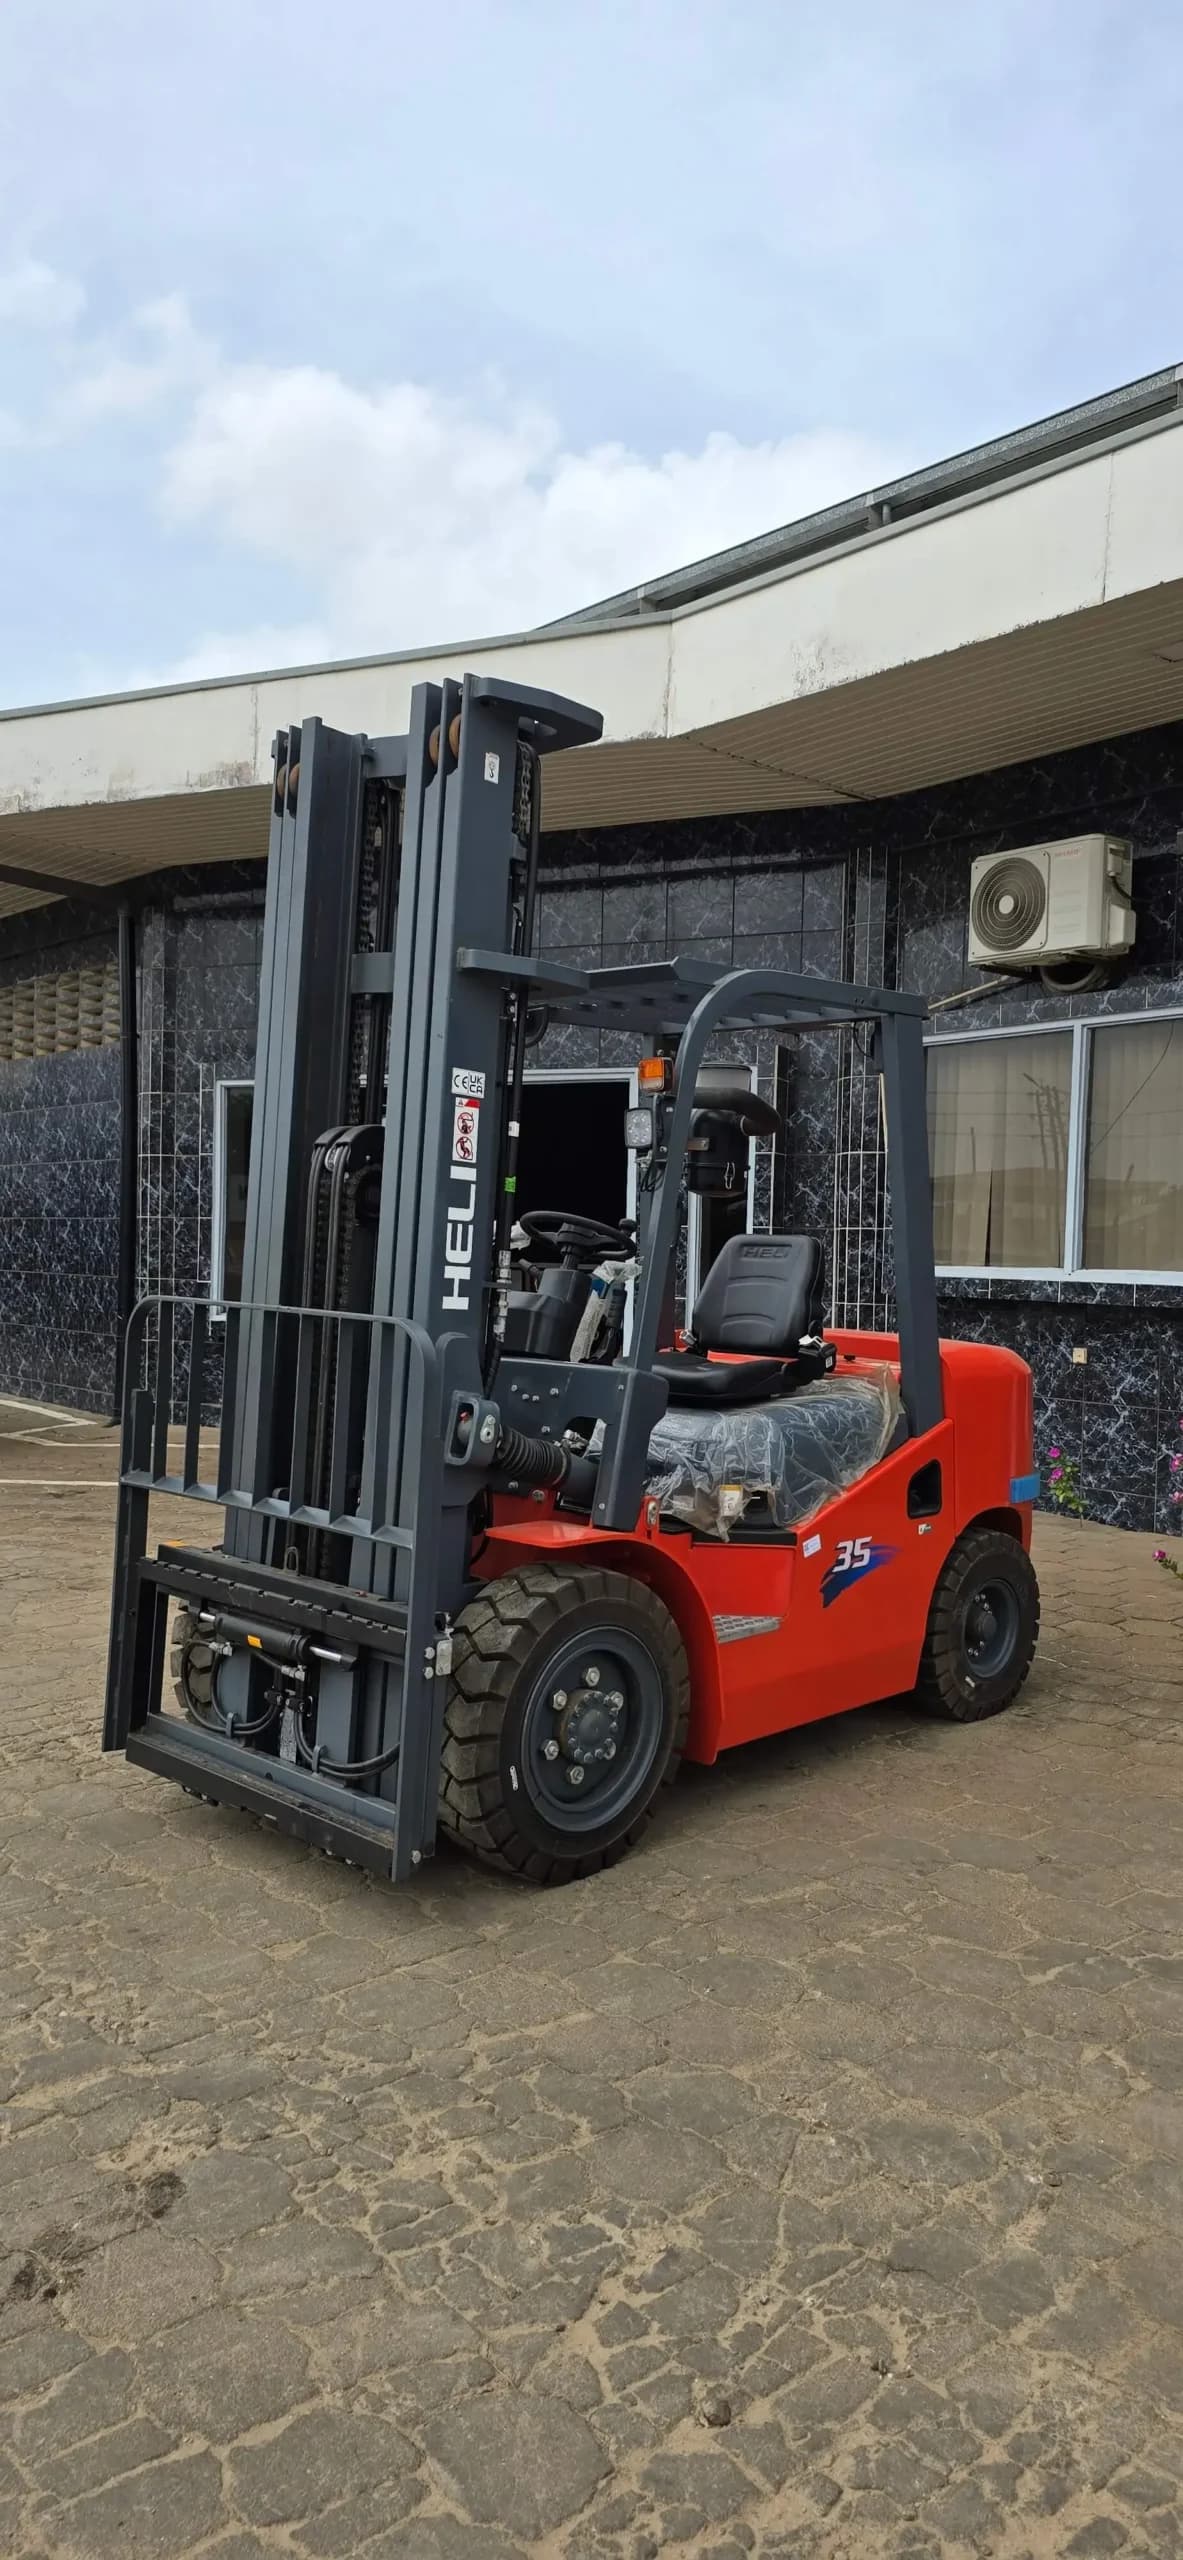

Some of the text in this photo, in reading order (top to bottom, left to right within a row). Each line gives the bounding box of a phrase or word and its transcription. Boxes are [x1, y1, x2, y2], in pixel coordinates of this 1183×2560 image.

[469, 1084, 483, 1094] CA
[470, 1074, 484, 1085] UK
[442, 1165, 477, 1311] HELI
[832, 1536, 873, 1573] 35
